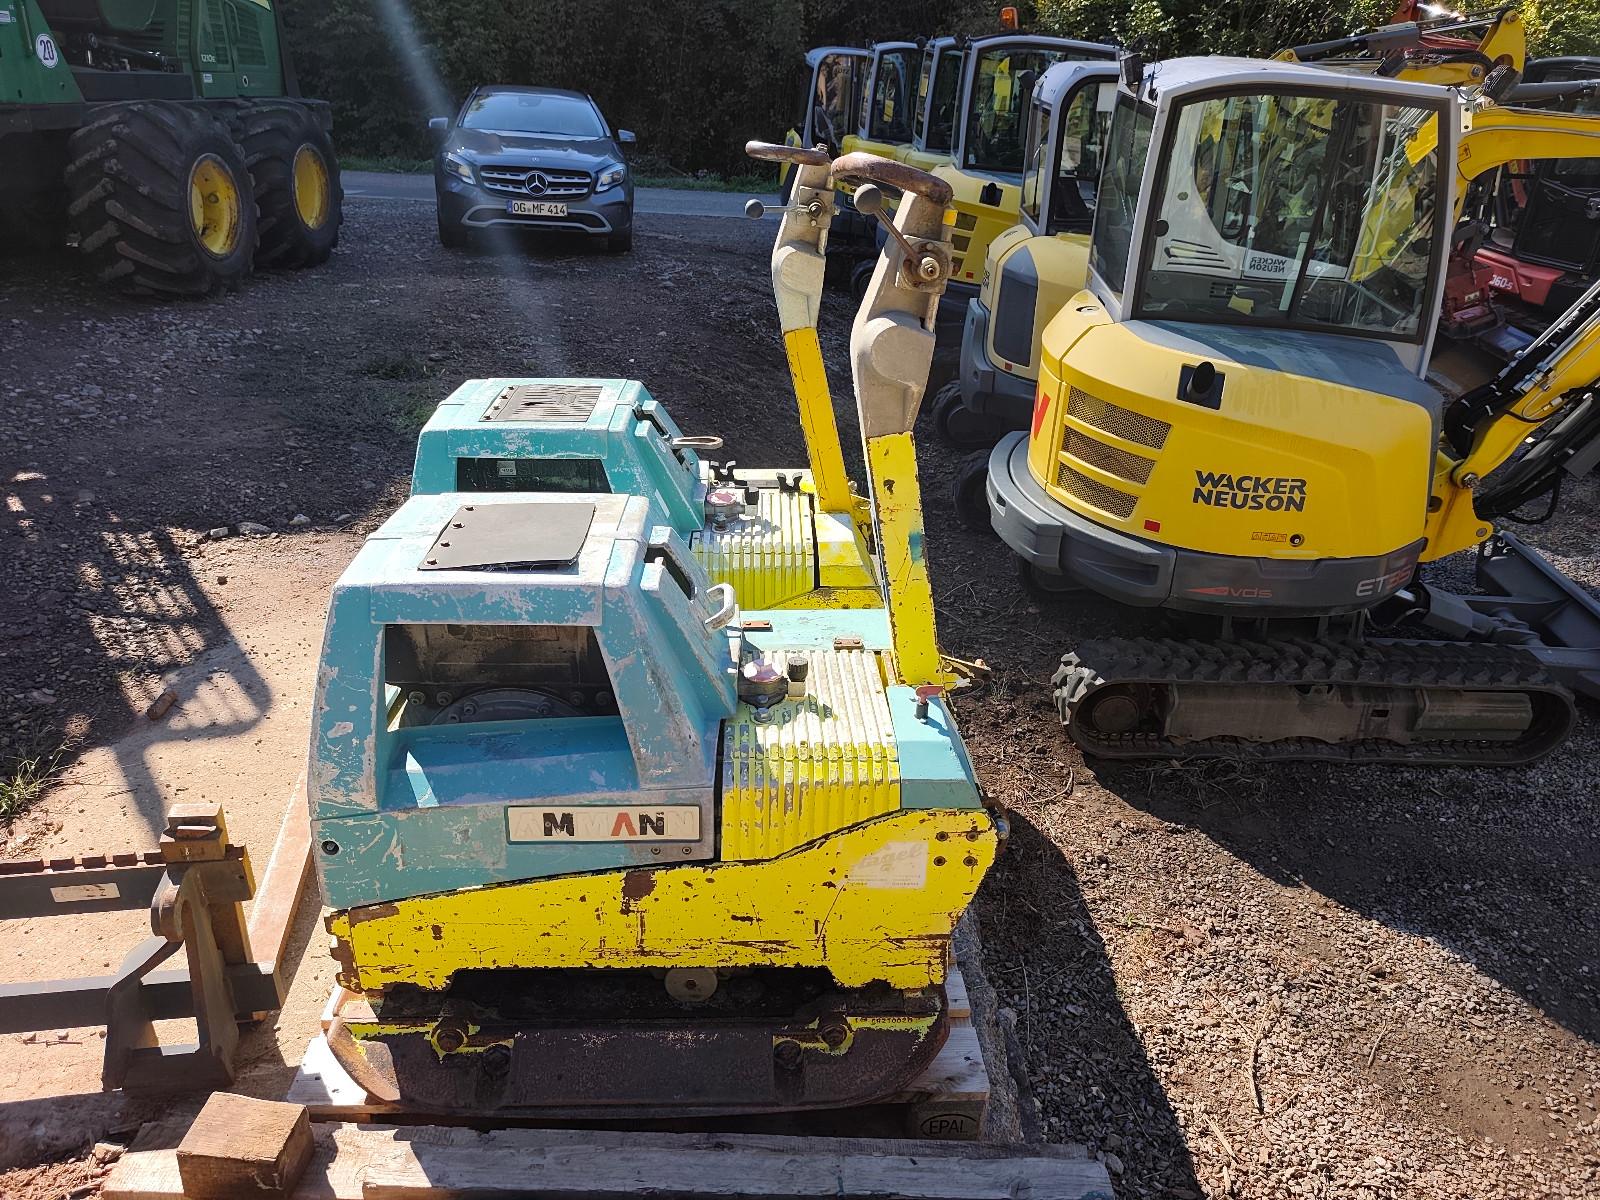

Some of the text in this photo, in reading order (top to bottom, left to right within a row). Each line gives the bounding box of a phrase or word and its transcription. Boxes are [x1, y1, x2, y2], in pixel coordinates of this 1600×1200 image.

[40, 40, 54, 60] 20
[513, 202, 566, 215] OG MF 414
[1195, 469, 1307, 495] WACKER
[1192, 487, 1306, 512] NEUSON
[929, 1119, 969, 1134] EPAL
